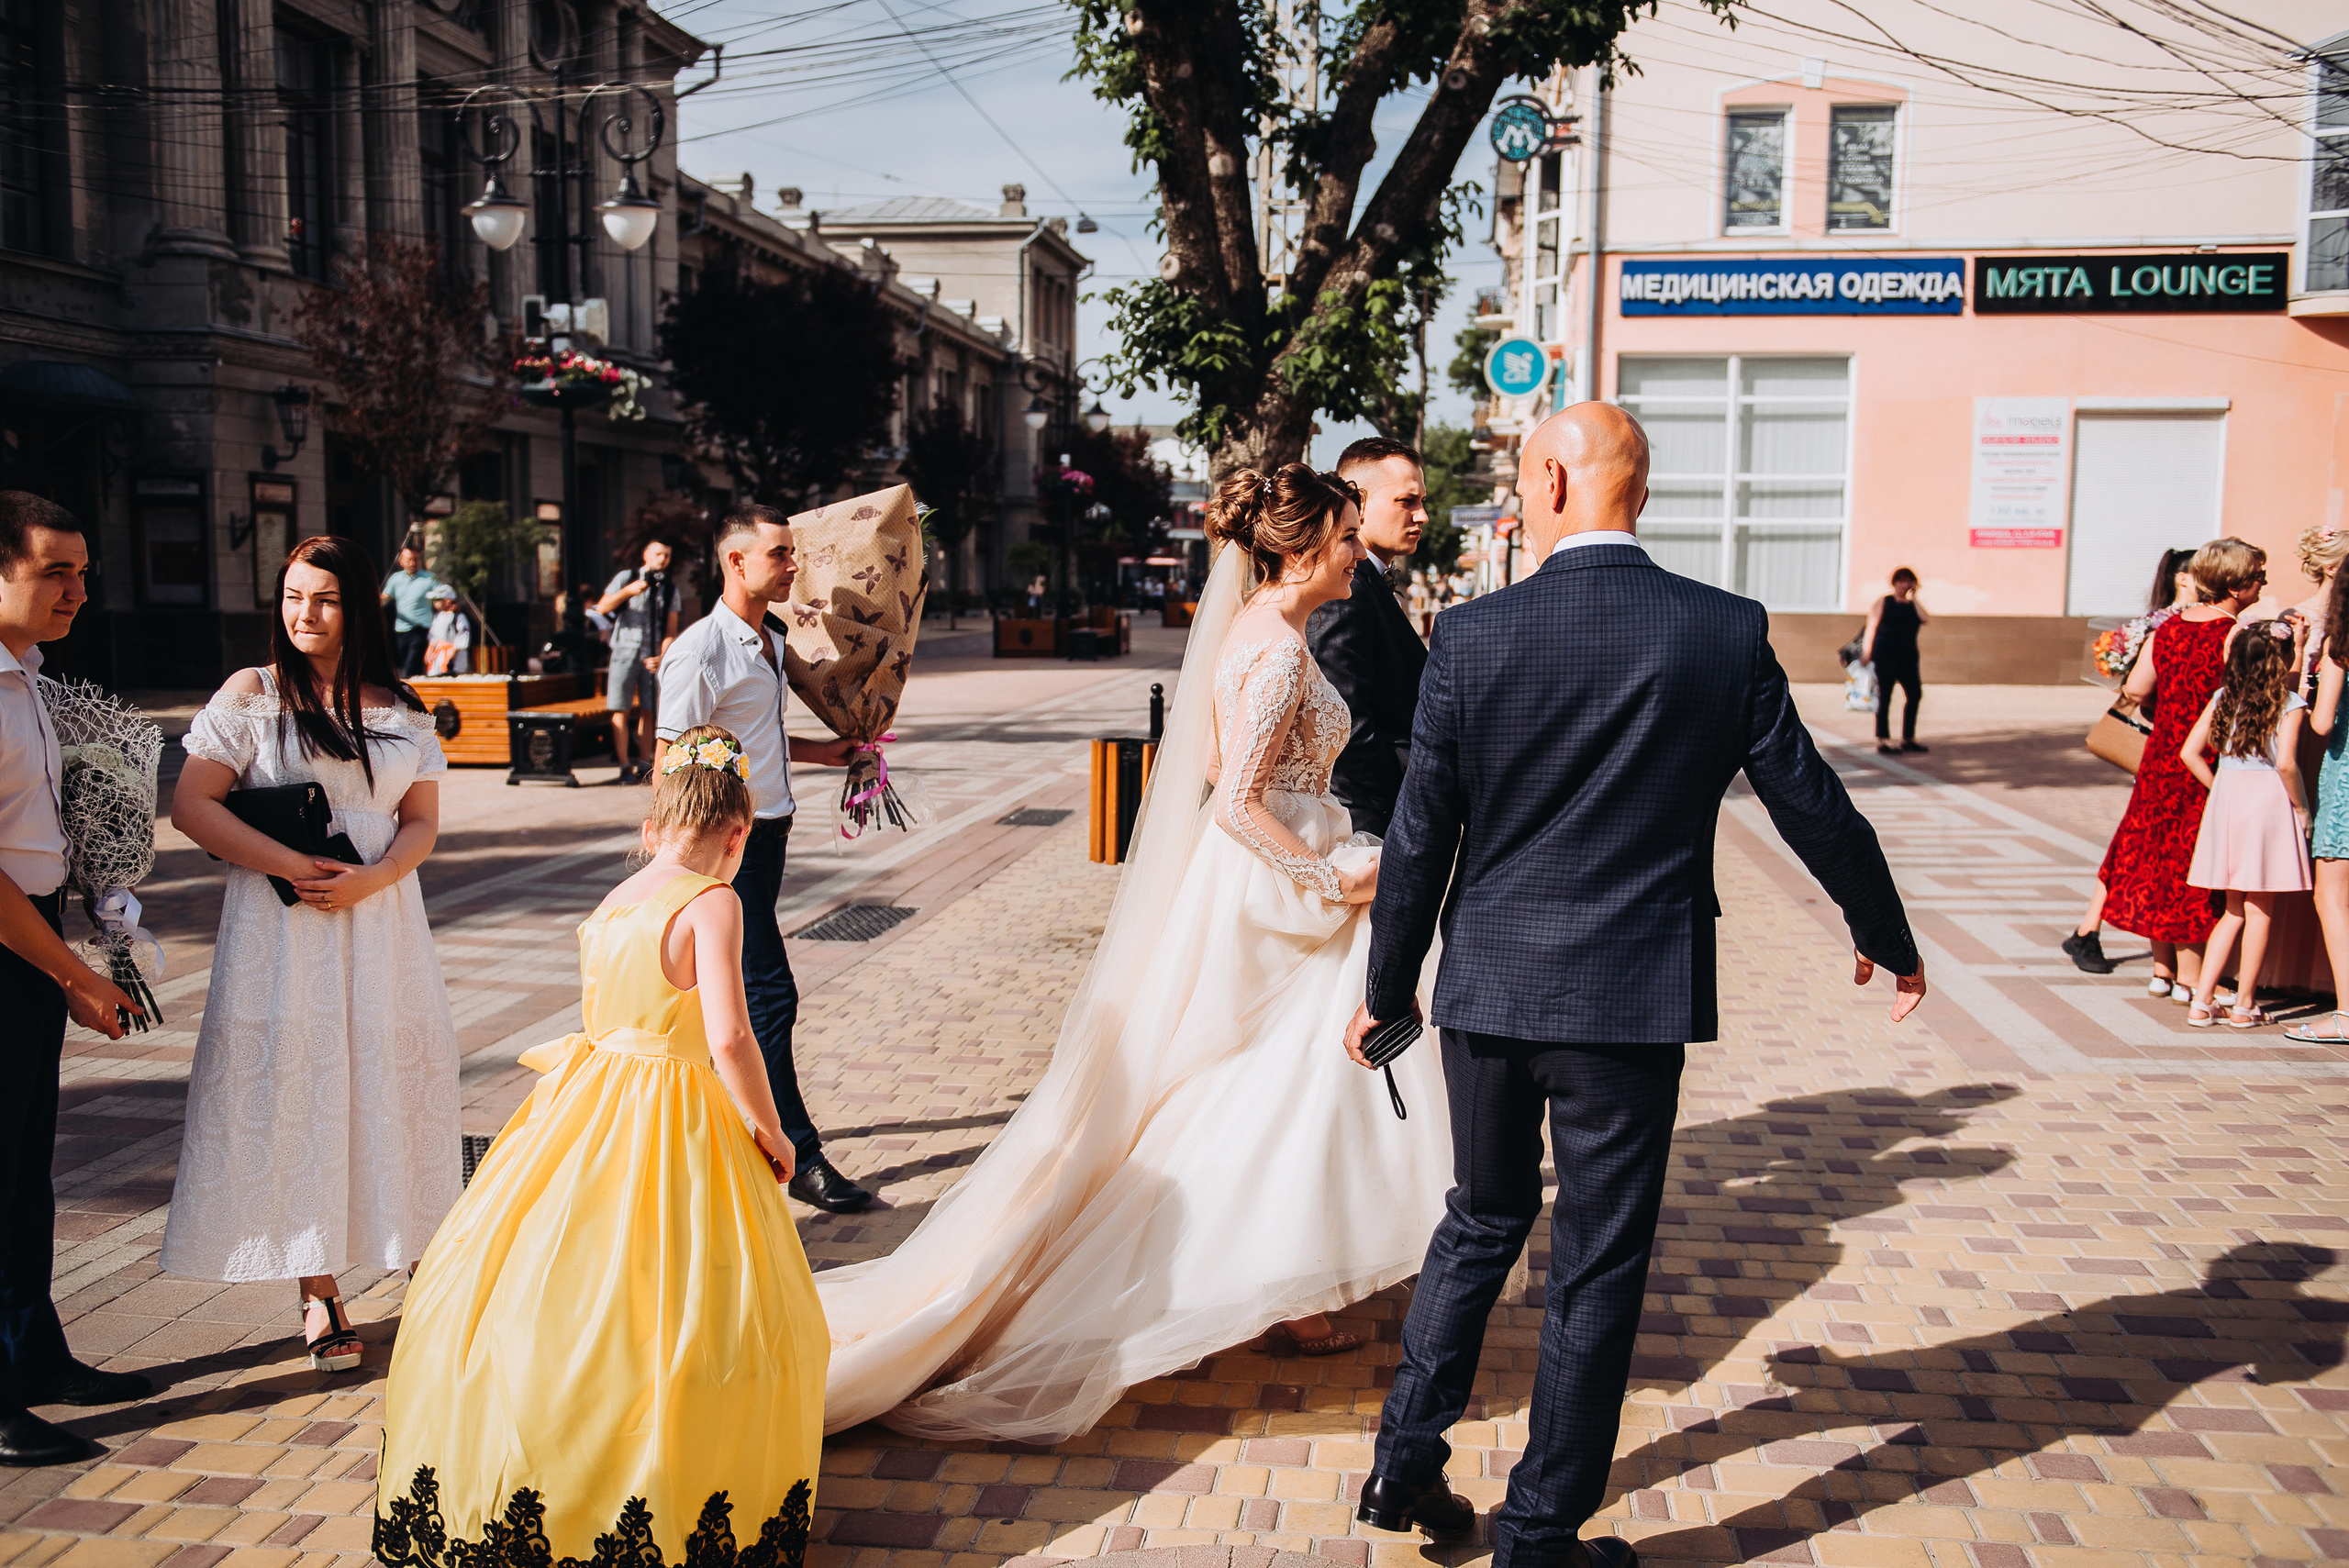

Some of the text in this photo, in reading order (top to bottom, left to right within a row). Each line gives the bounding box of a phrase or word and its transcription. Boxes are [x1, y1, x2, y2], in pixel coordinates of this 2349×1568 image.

[1621, 272, 1964, 304] МЕДИЦИНСКАЯ ОДЕЖДА
[1986, 265, 2274, 297] МЯТА LOUNGE
